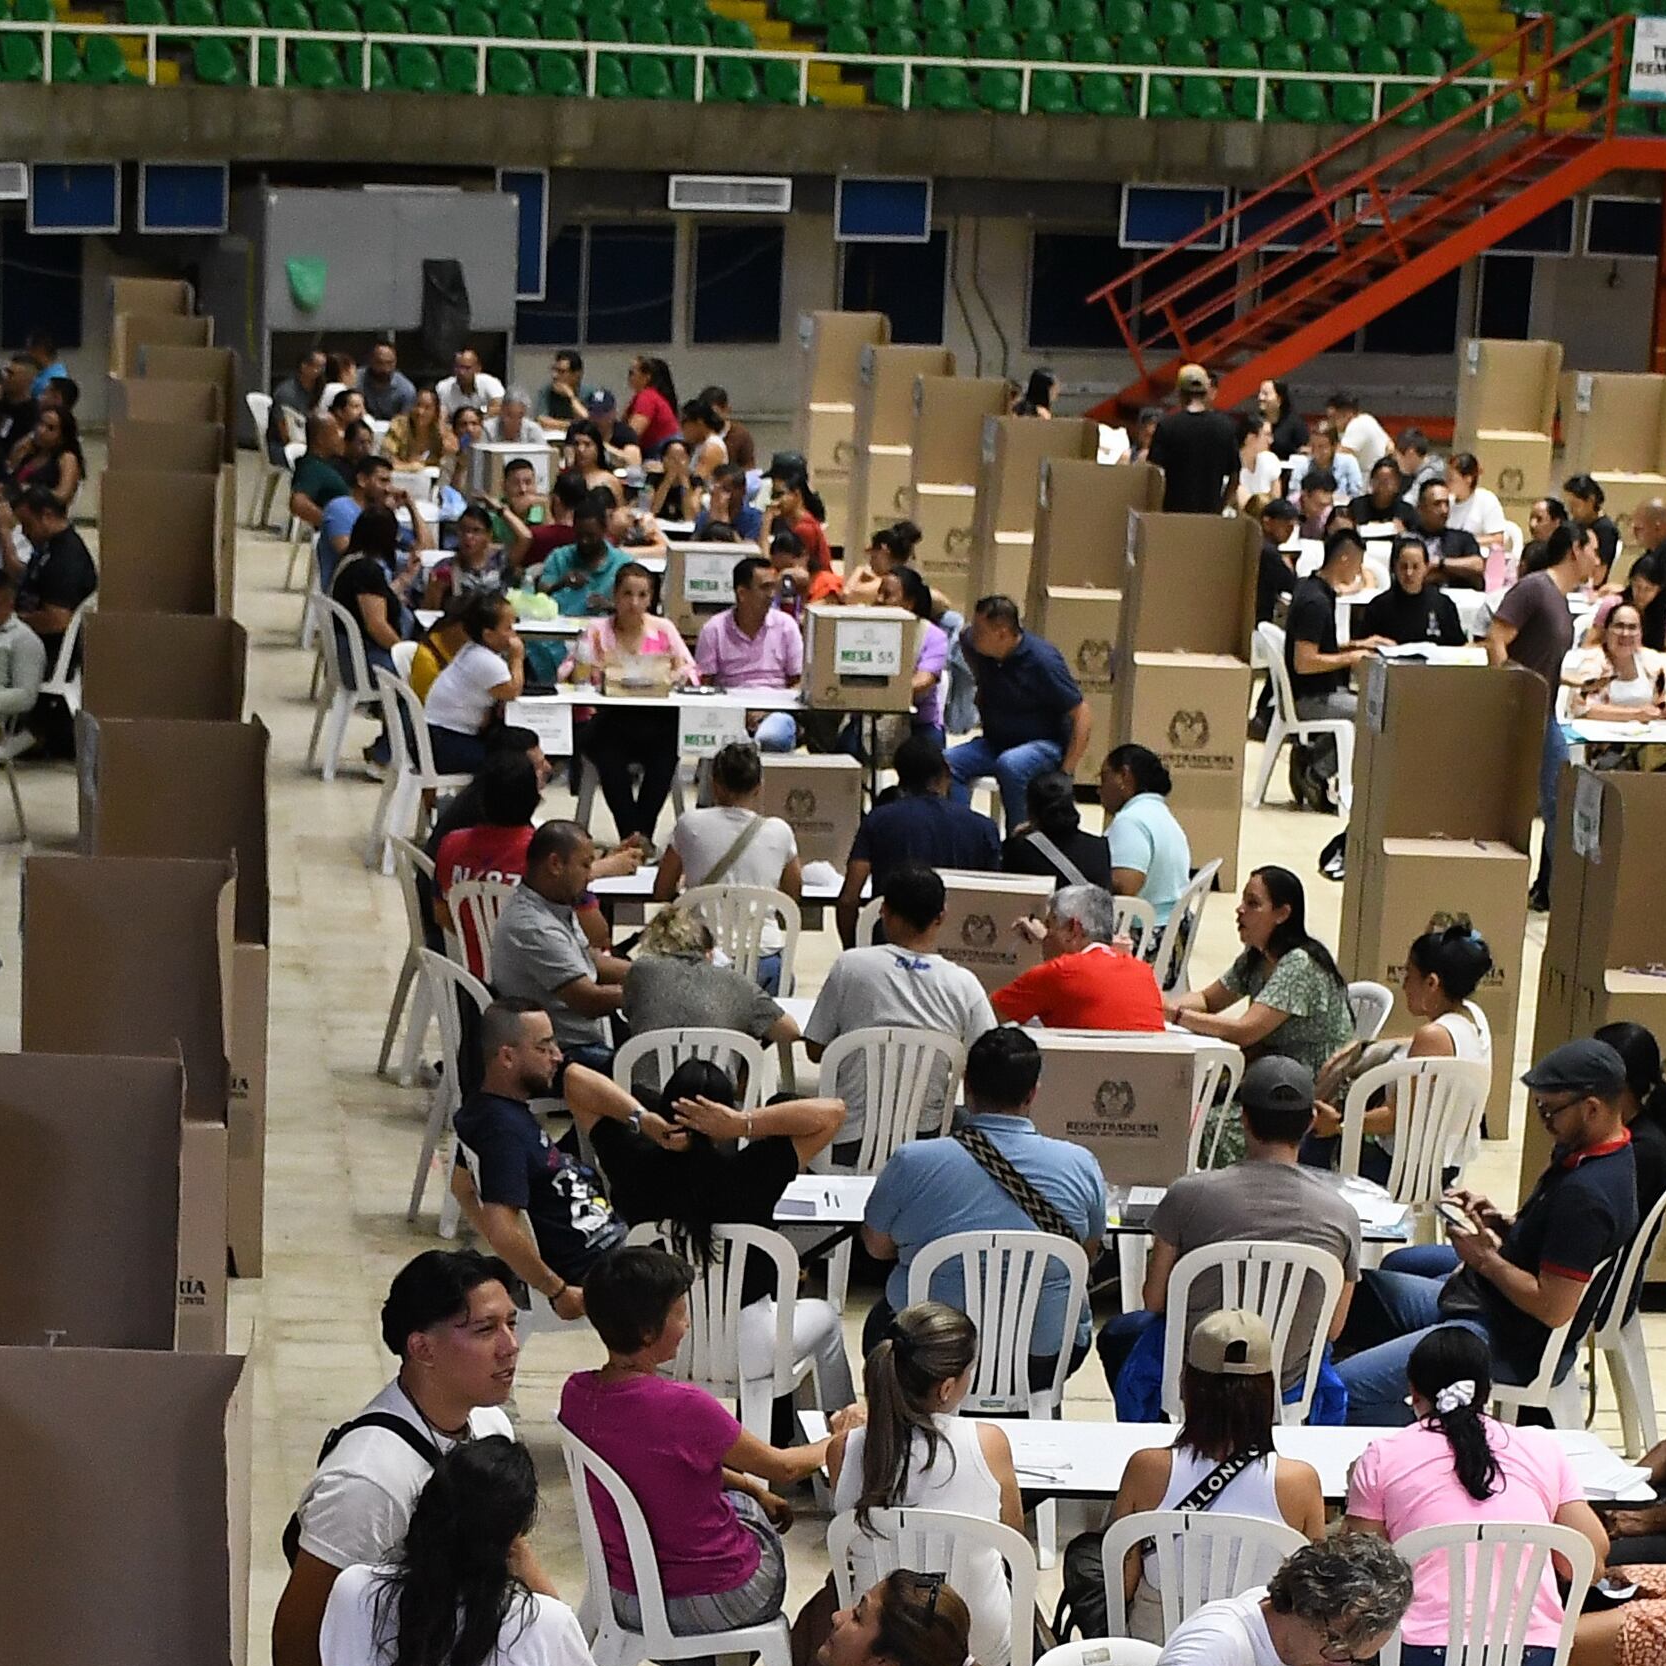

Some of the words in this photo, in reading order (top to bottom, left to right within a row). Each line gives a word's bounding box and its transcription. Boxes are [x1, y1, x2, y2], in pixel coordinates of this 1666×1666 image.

[841, 650, 872, 662] MESA
[877, 650, 896, 664] 55
[684, 734, 716, 746] MESA
